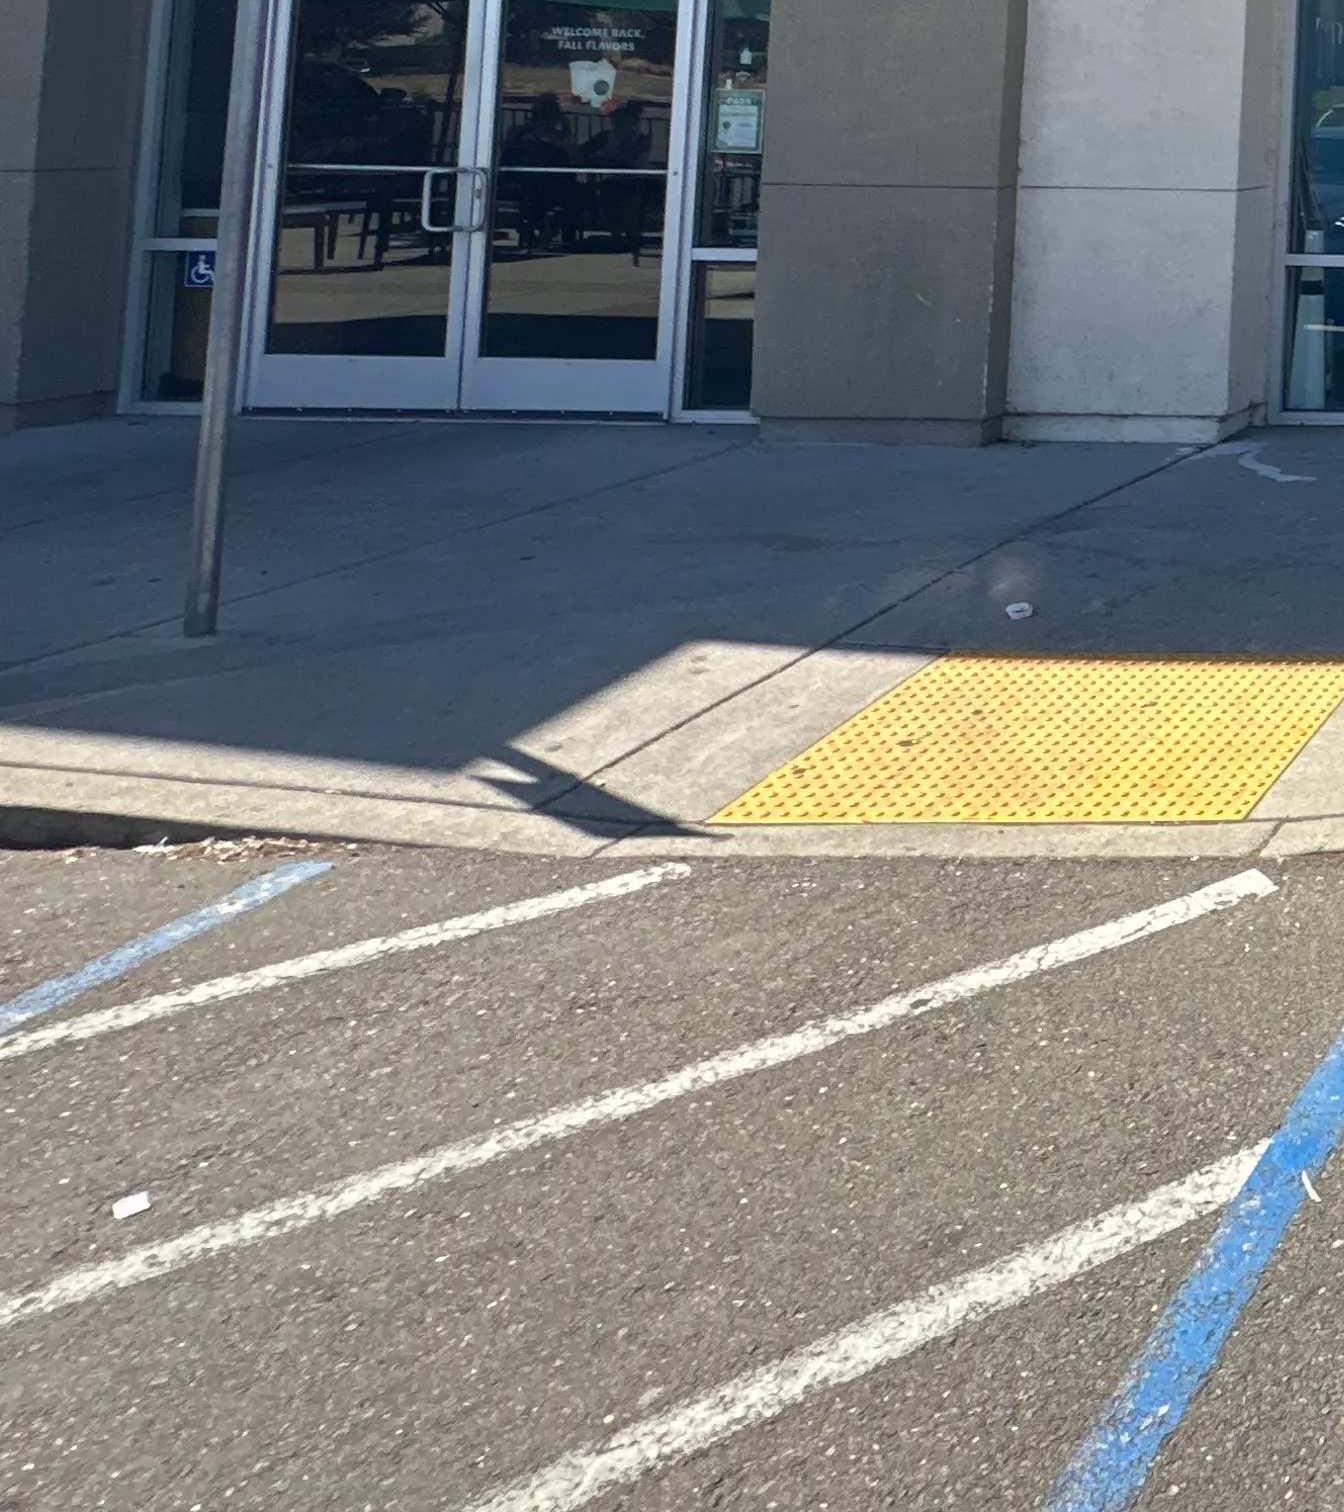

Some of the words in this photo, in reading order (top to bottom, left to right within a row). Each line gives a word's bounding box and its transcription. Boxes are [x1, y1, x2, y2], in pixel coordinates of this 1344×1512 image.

[551, 26, 609, 37] WELCOME
[558, 40, 583, 50] FALL
[586, 41, 635, 51] FLAVORS
